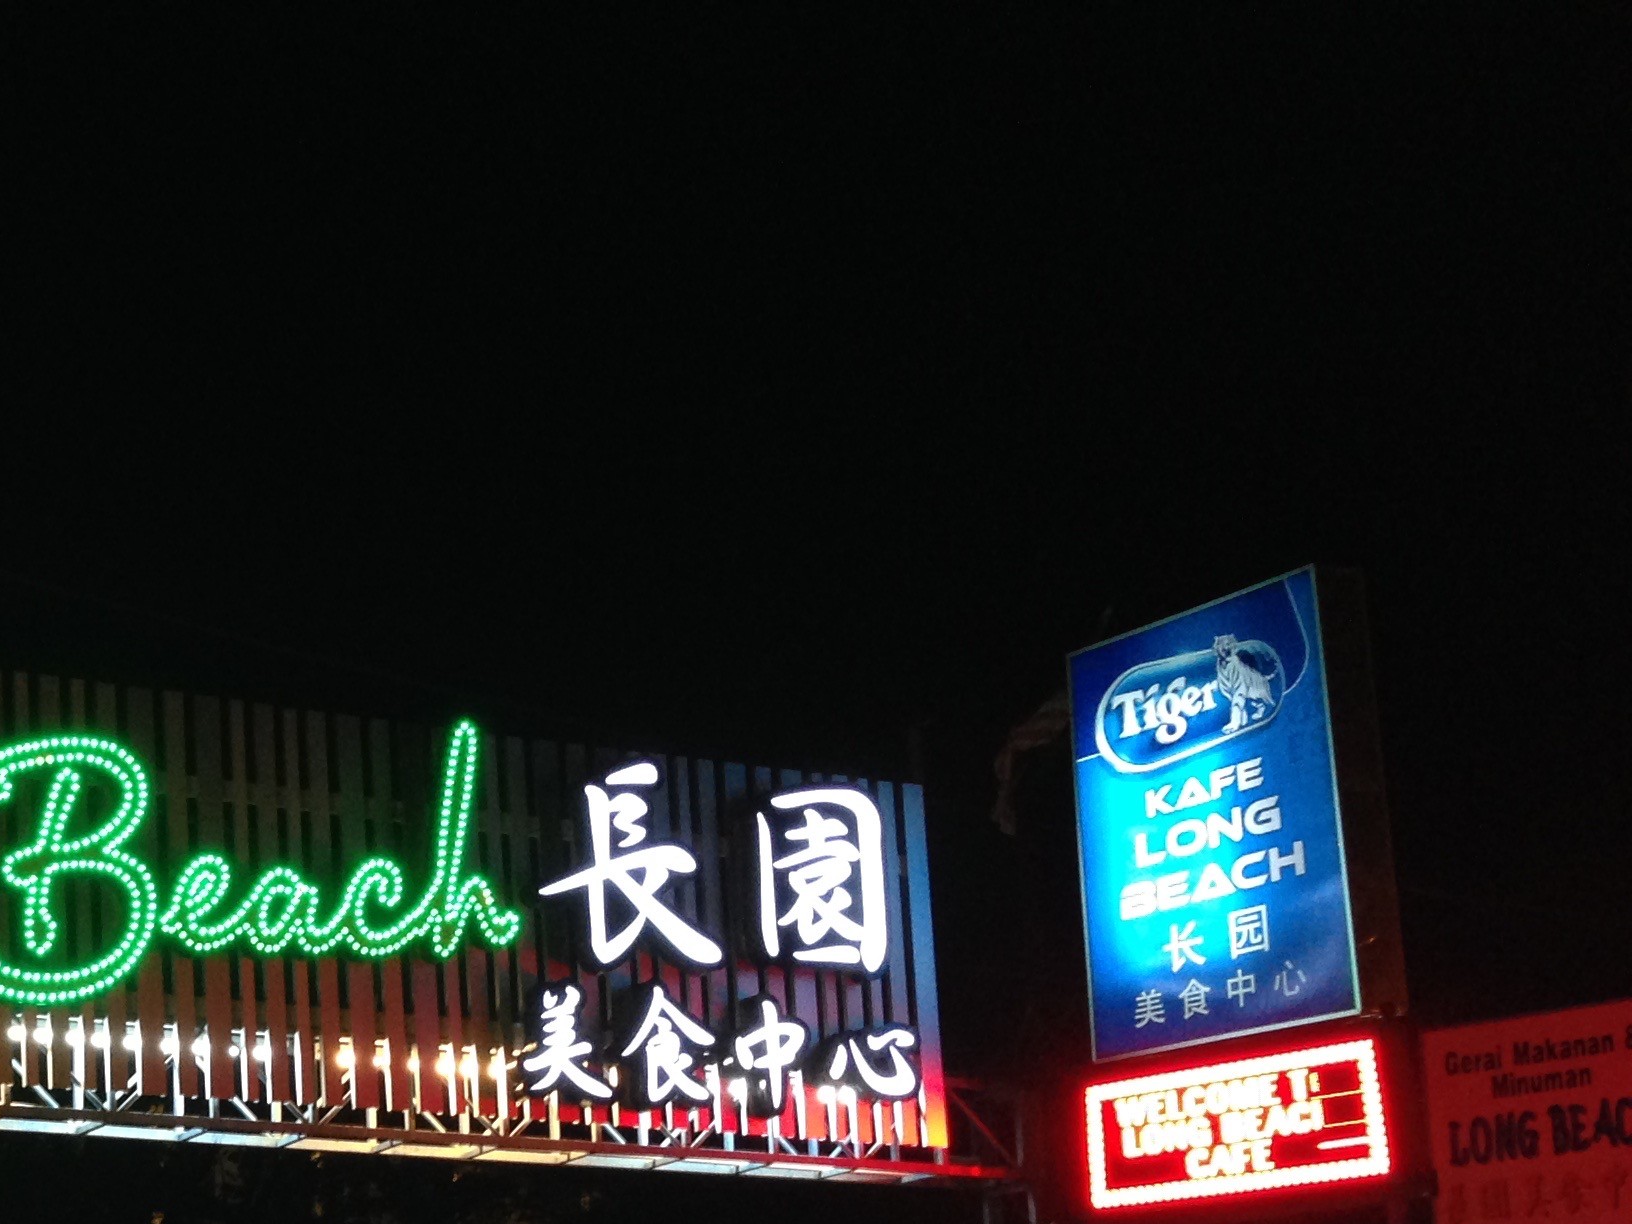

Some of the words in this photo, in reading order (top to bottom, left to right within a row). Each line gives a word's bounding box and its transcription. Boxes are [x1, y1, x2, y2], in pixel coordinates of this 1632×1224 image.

[1111, 675, 1218, 744] Tiger
[1144, 757, 1264, 818] KAFE
[1134, 795, 1282, 869] LONG
[539, 761, 890, 974] 長園
[1119, 840, 1307, 921] BEACH
[1162, 904, 1270, 973] 长园
[1134, 959, 1307, 1029] 美食中心
[523, 984, 918, 1111] 美食中心
[1445, 1045, 1502, 1077] Gerai
[1513, 1034, 1615, 1067] Makanan
[1113, 1073, 1282, 1129] WELCOME
[1491, 1067, 1591, 1099] Minuman
[1121, 1117, 1213, 1160] LONG
[1185, 1138, 1275, 1180] CAFE
[1448, 1110, 1539, 1168] LONG
